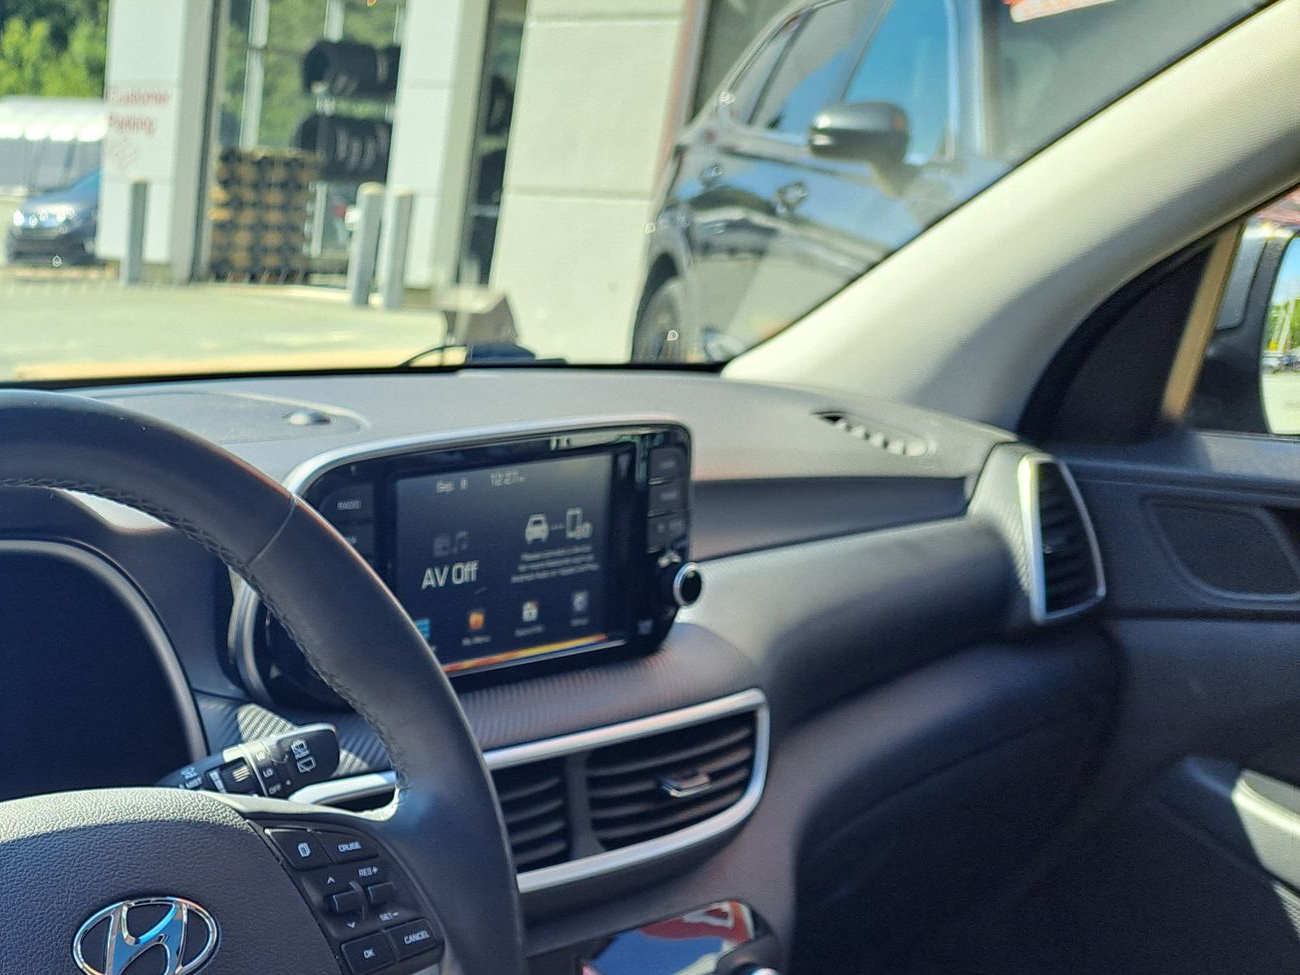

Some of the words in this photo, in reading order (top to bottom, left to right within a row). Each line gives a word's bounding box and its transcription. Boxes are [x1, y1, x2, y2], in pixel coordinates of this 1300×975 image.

[421, 566, 449, 590] AV
[452, 559, 480, 585] Off
[338, 841, 362, 852] CRUISE
[403, 930, 430, 945] CANCEL
[363, 948, 376, 959] OK
